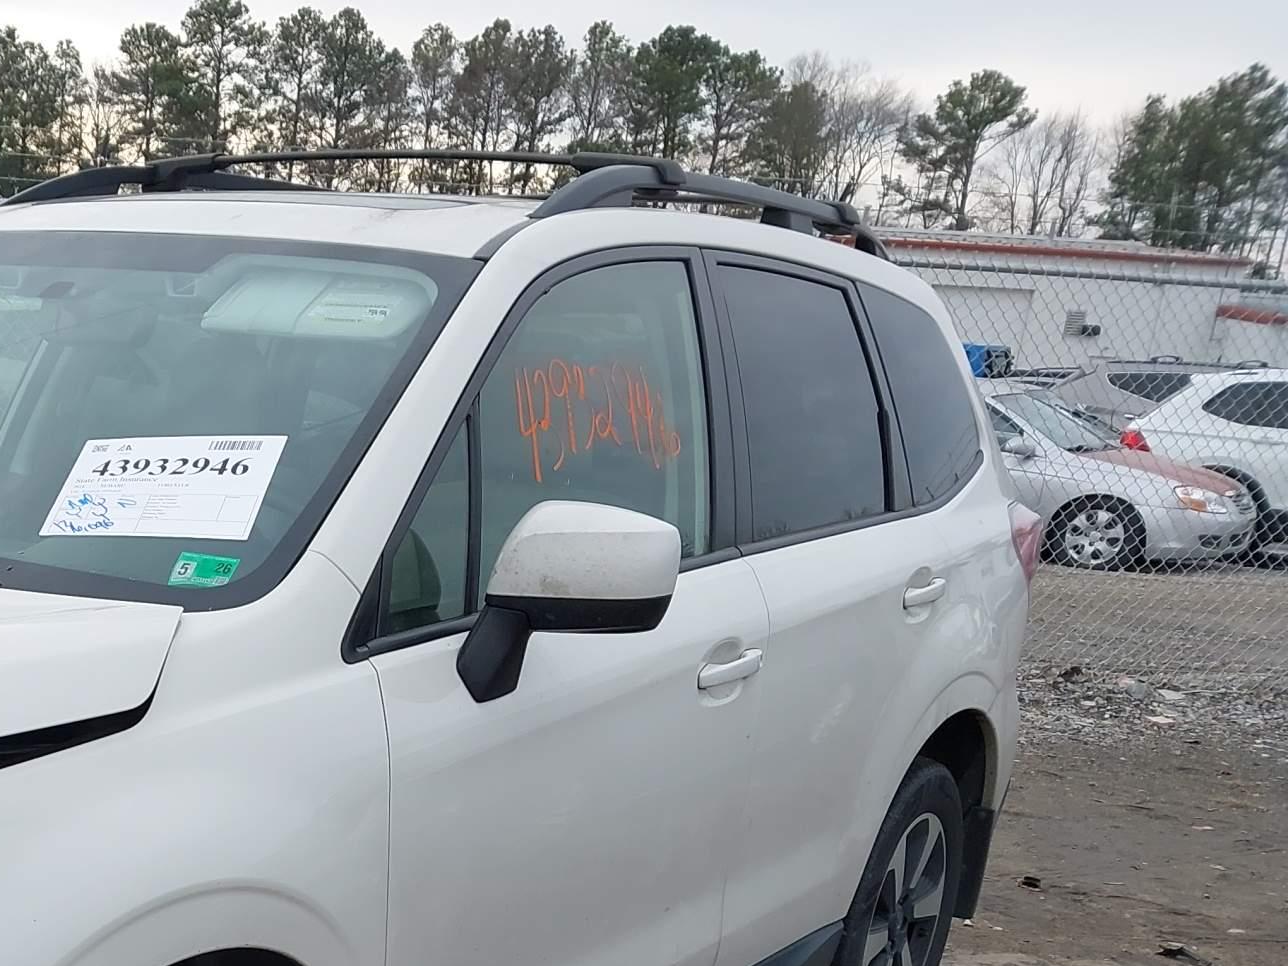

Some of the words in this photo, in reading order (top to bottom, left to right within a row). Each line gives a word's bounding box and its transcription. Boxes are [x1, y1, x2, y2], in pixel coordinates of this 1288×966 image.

[92, 457, 254, 476] 43932946
[178, 562, 191, 576] 5
[215, 562, 233, 575] 26
